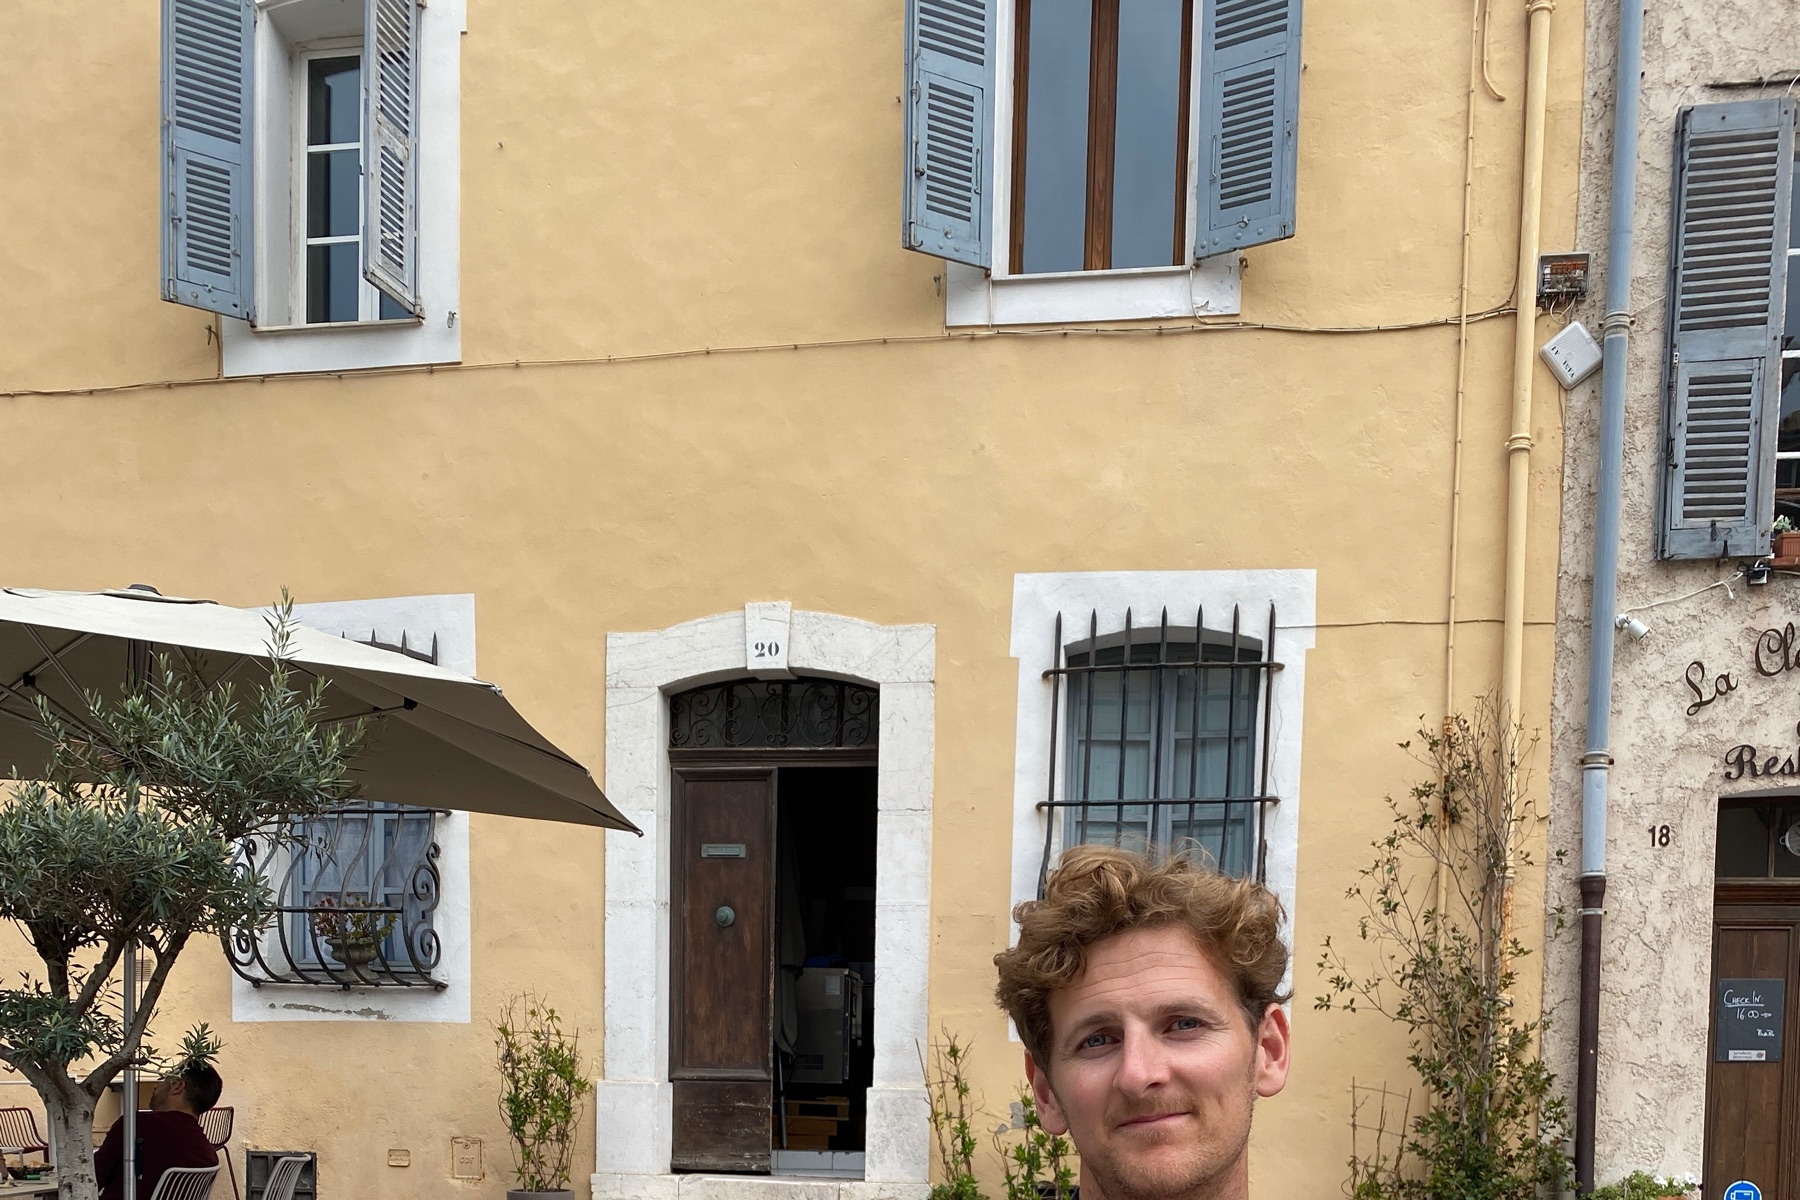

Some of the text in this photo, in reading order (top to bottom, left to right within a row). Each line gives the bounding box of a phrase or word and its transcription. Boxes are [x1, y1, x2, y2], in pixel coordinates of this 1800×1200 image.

[754, 641, 780, 658] 20
[1685, 660, 1739, 717] La
[1647, 824, 1671, 848] 18
